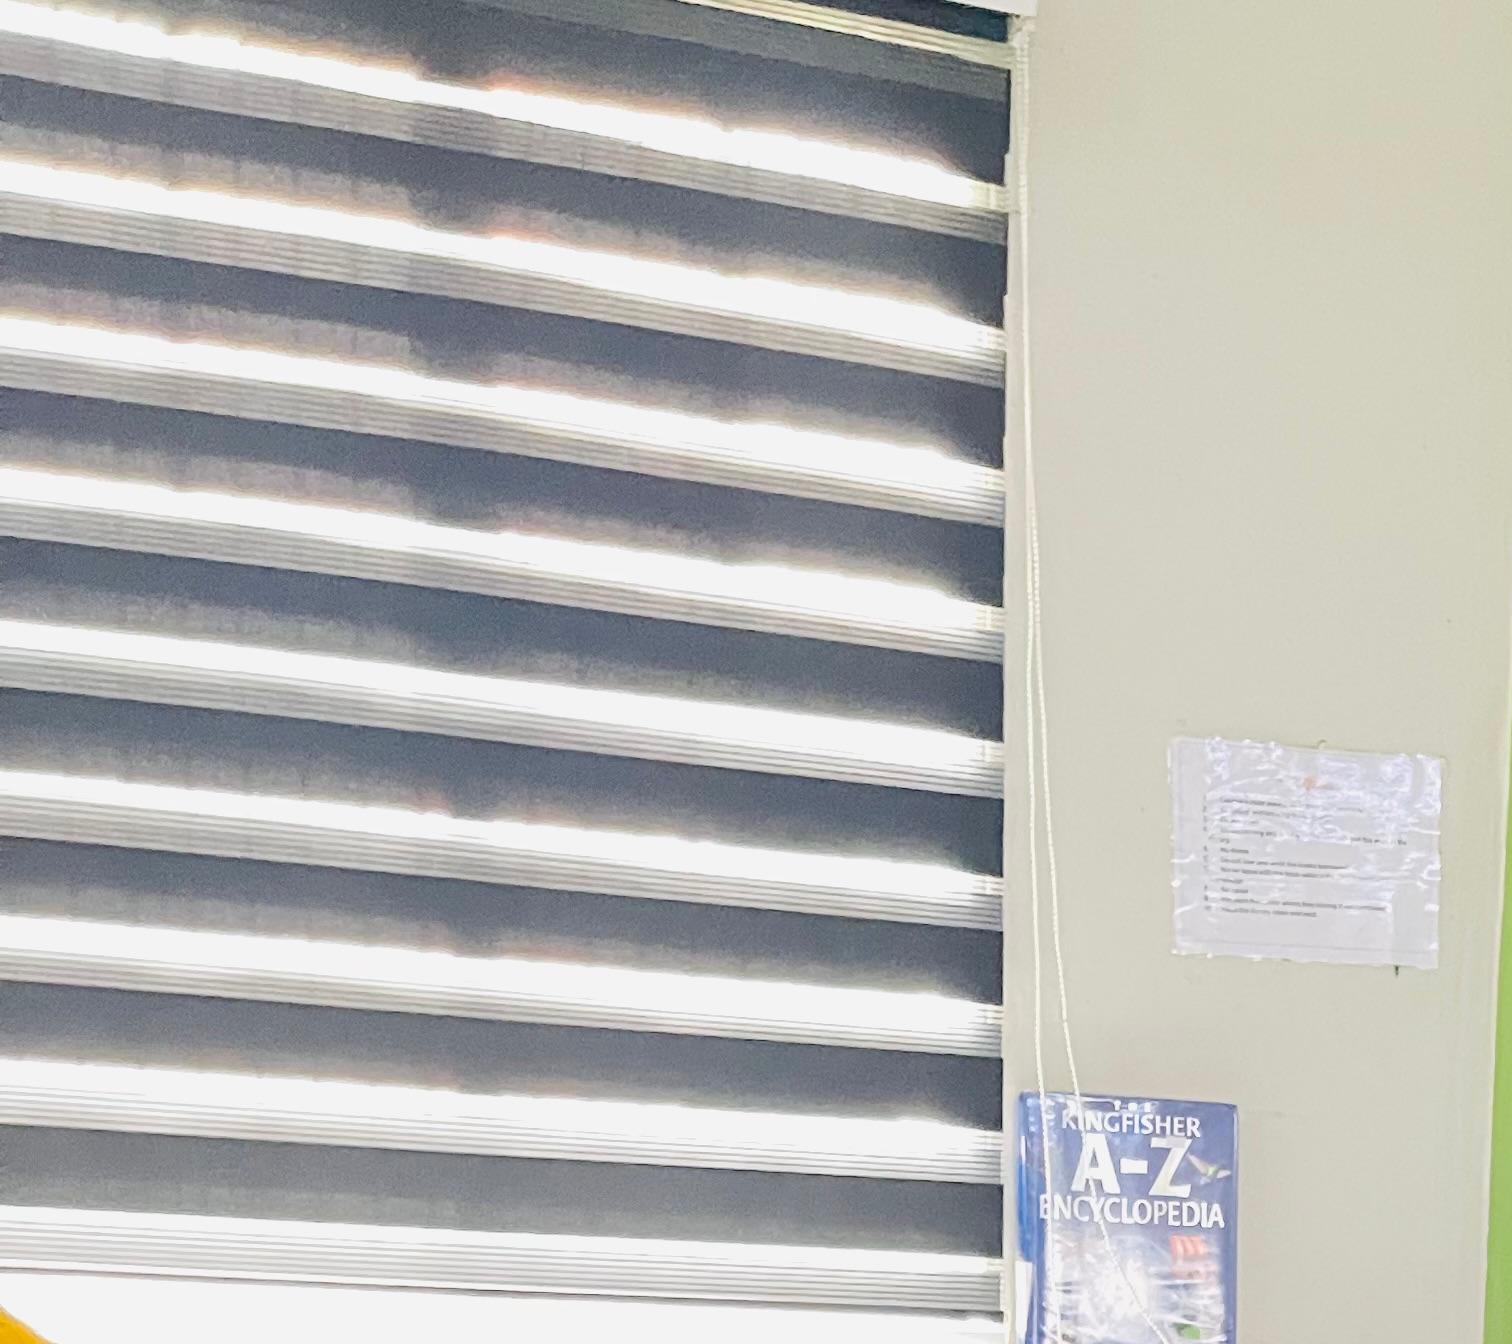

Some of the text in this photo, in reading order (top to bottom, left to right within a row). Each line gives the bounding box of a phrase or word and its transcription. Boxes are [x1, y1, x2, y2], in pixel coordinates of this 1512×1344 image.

[1061, 1109, 1201, 1138] KINGFISHER
[1071, 1133, 1193, 1198] A-Z
[1039, 1193, 1225, 1229] ENCYCLOPEDIA
